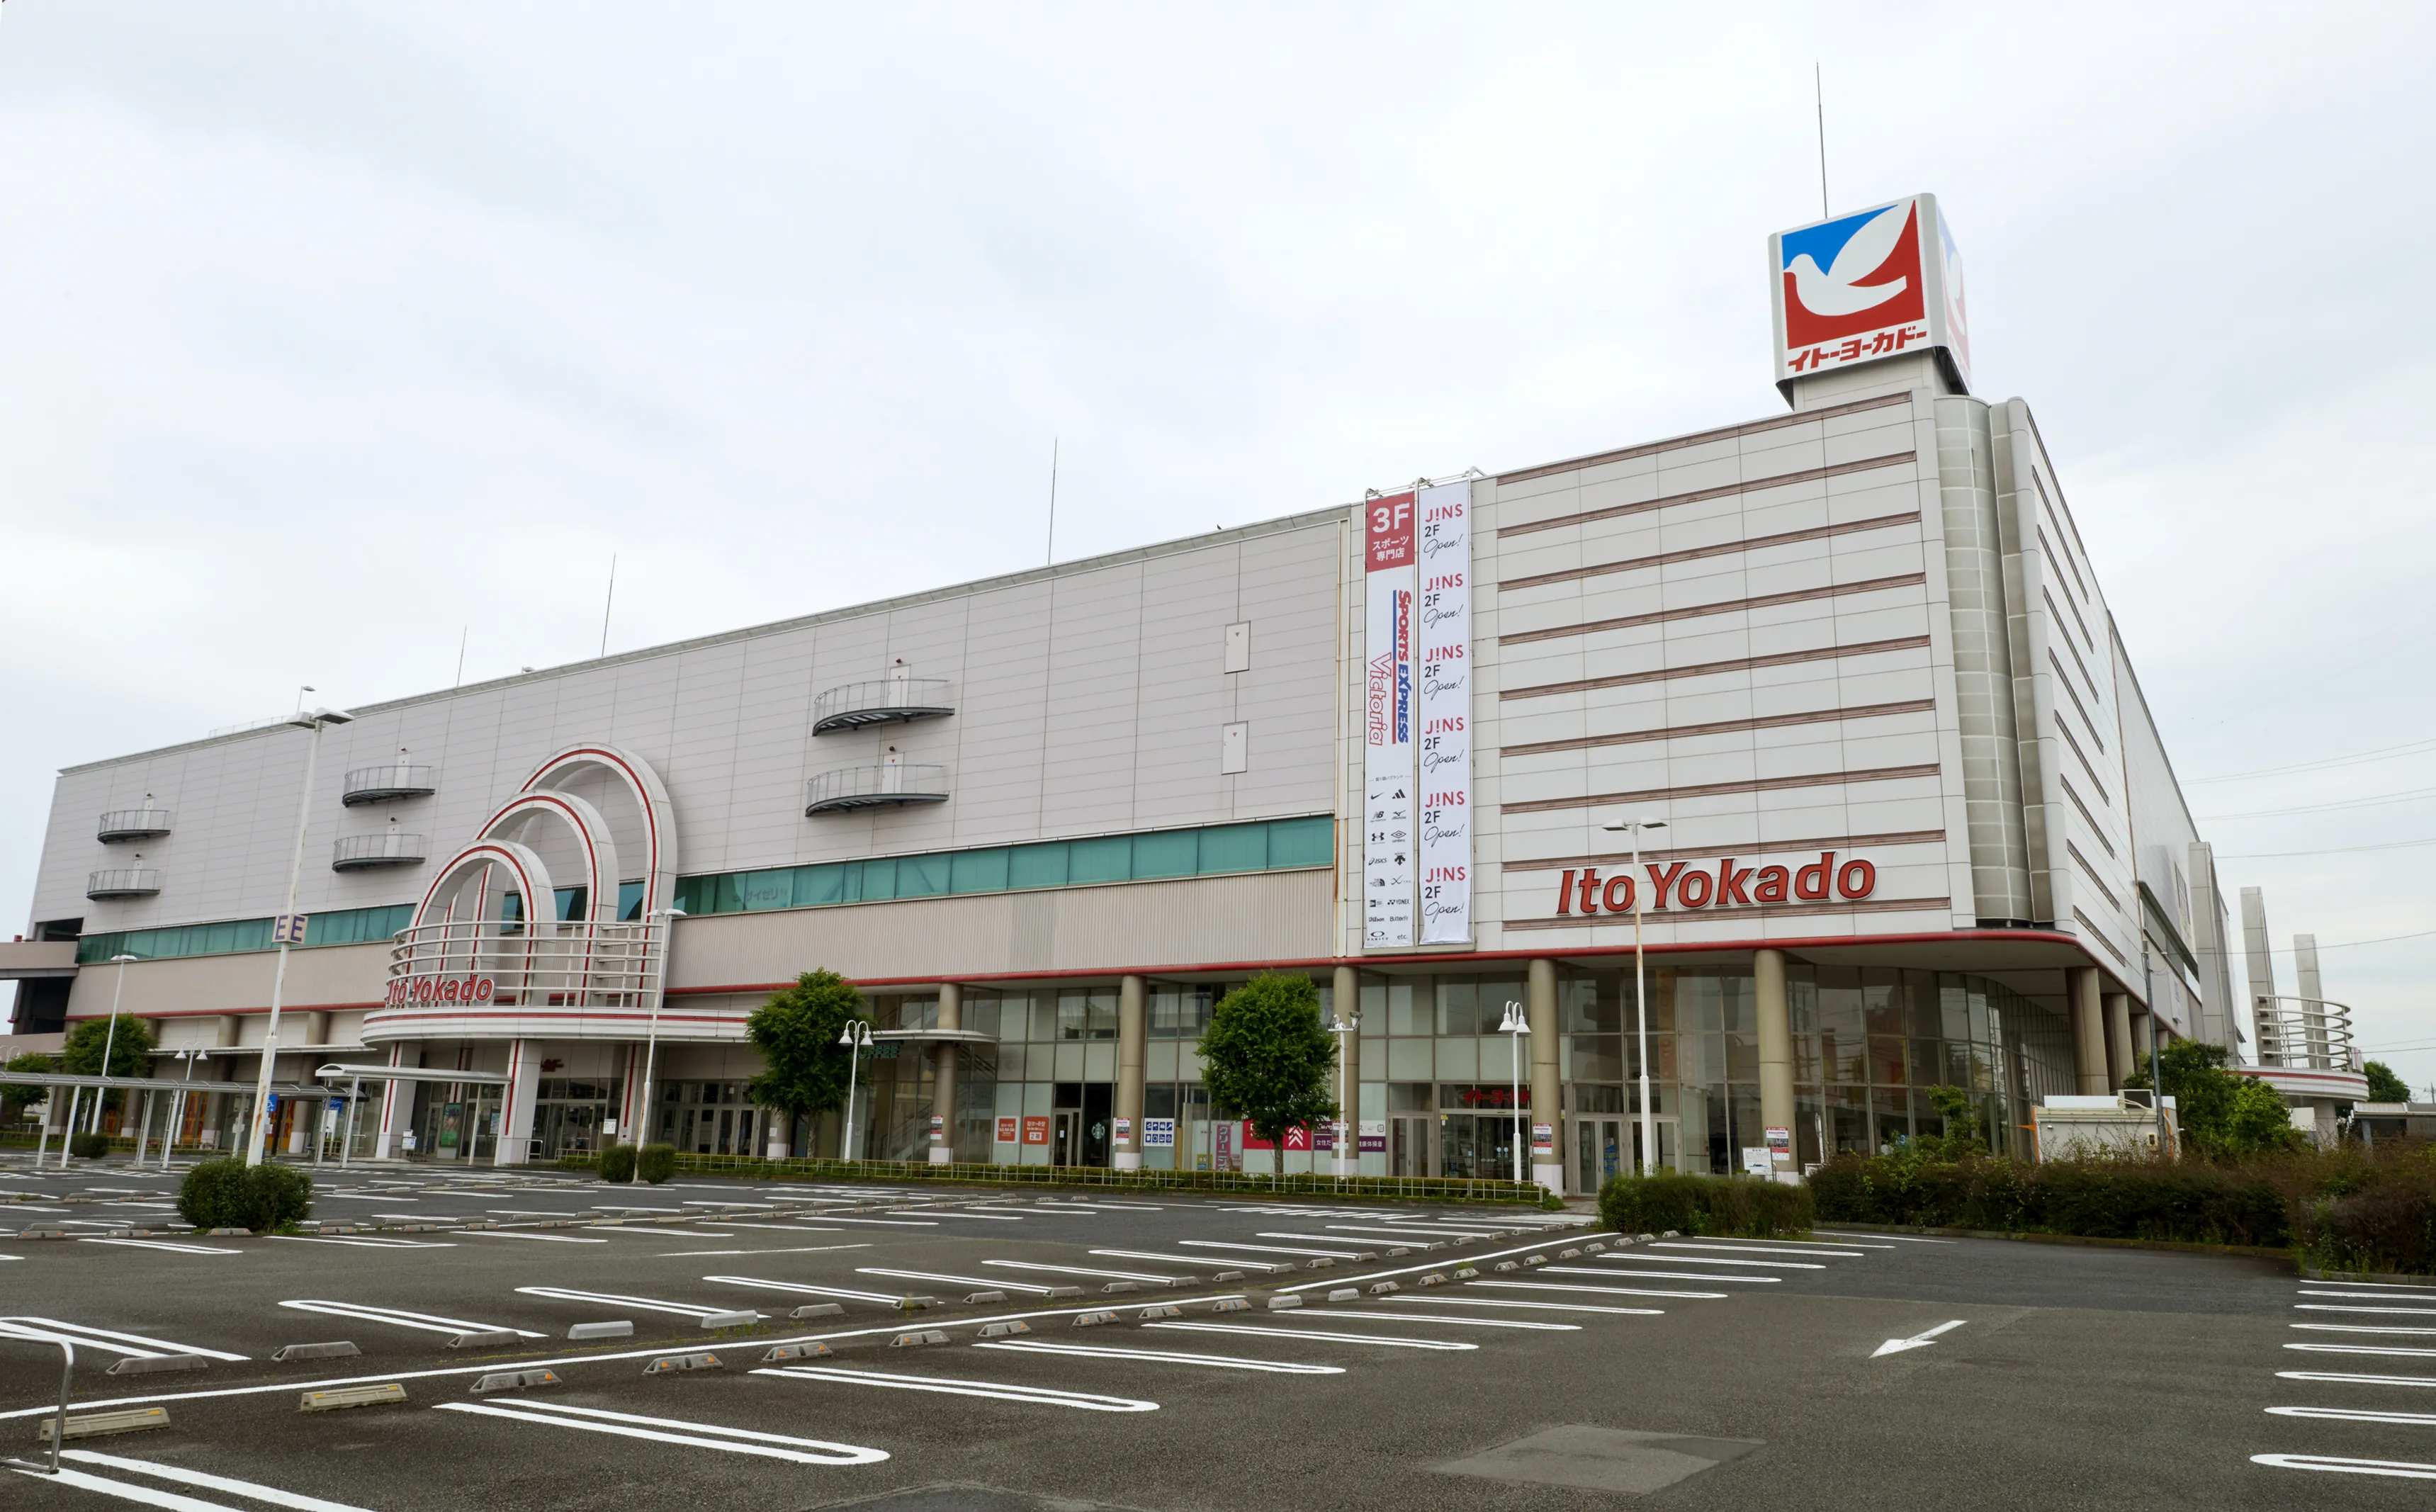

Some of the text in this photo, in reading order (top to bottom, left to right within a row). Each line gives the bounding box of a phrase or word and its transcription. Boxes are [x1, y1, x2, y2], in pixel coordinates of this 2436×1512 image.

[1788, 325, 1927, 372] イトーヨーカドー
[1372, 502, 1410, 533] 3F
[1372, 536, 1409, 551] スポーツ
[1424, 524, 1440, 538] 2F
[1376, 548, 1404, 561] 専門店
[1423, 534, 1463, 559] Open!
[1424, 594, 1440, 607] 2F
[1423, 604, 1464, 629] Open!
[1398, 589, 1411, 743] SPORTS EXPRESS
[1424, 665, 1440, 678] 2F
[1369, 652, 1392, 745] Victoria
[1423, 676, 1465, 701] Open!
[1424, 737, 1440, 750] 2F
[1423, 749, 1465, 774] Open!
[1424, 811, 1441, 824] 2F
[1424, 823, 1465, 847] Open!
[1425, 886, 1441, 898] 2F
[1556, 851, 1876, 915] Ito Yokado
[1424, 901, 1465, 923] Open!
[275, 915, 288, 940] E
[290, 915, 305, 942] E
[387, 974, 495, 1005] Ito Yokado
[857, 1044, 898, 1059] OFFEE
